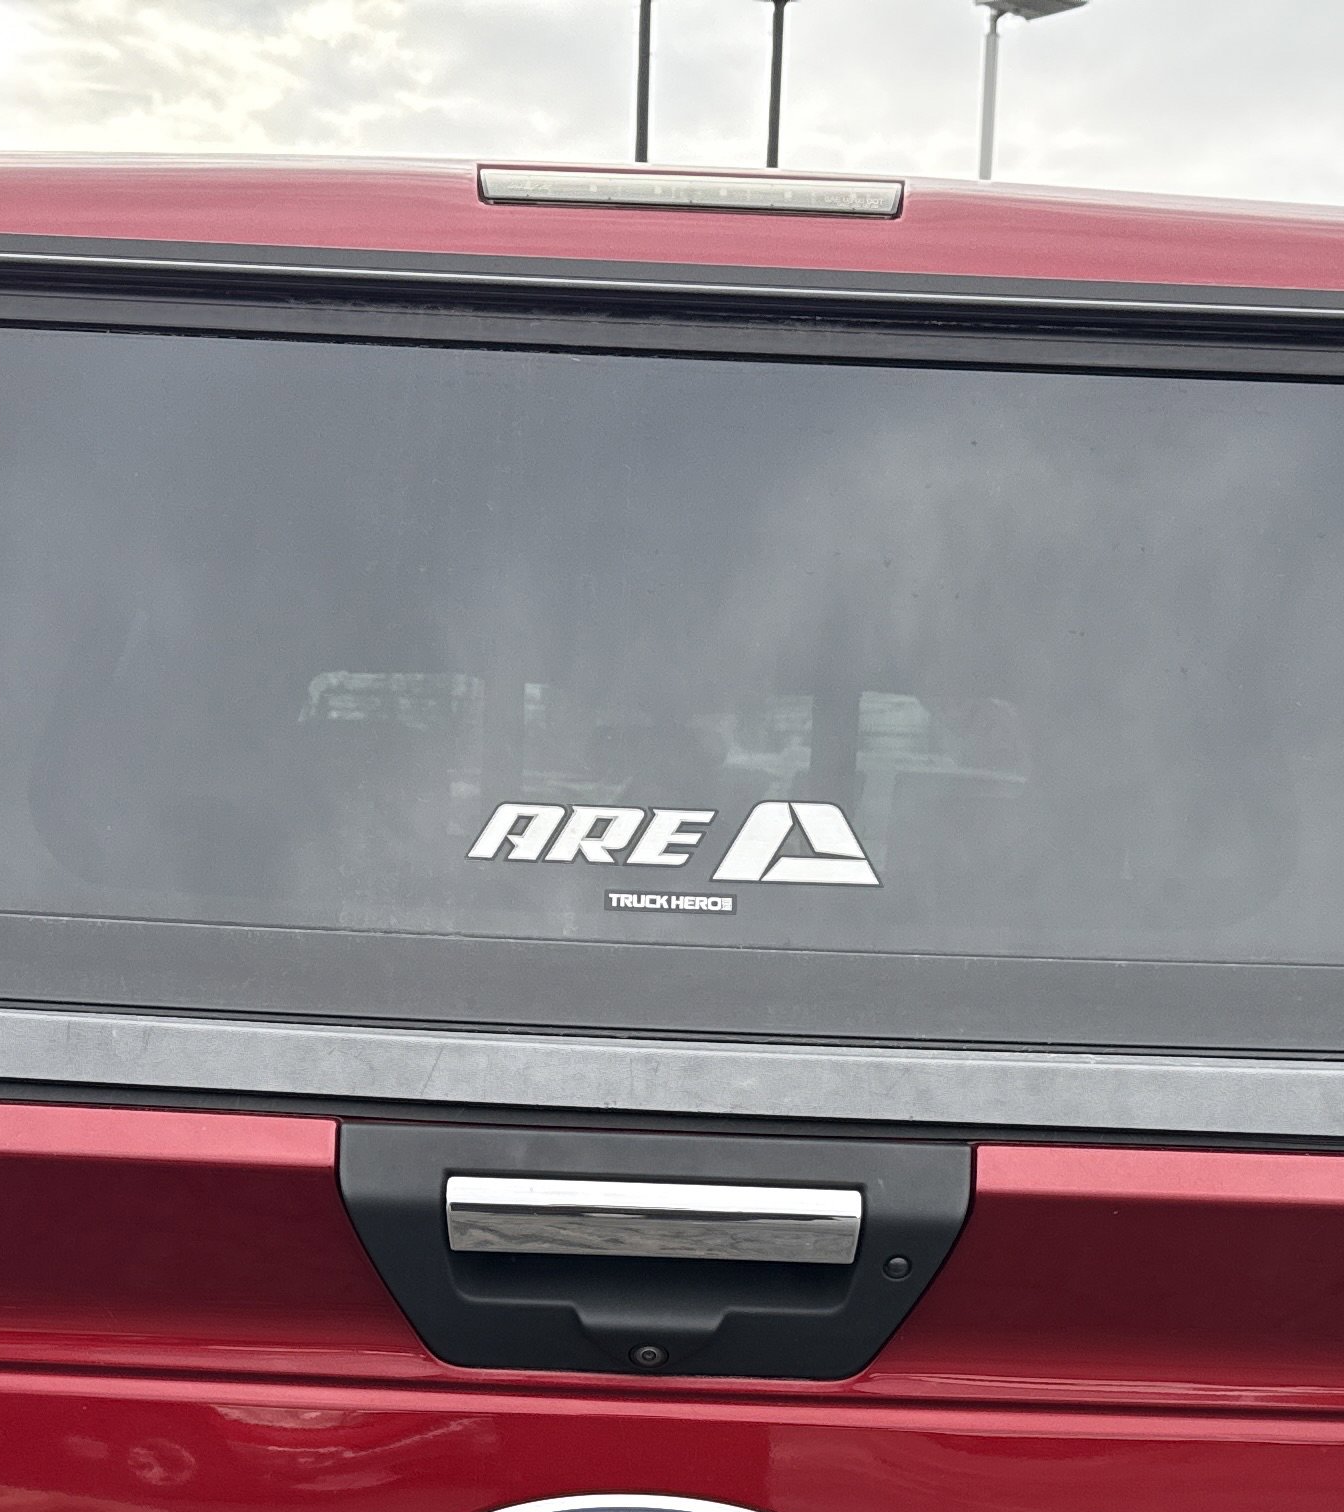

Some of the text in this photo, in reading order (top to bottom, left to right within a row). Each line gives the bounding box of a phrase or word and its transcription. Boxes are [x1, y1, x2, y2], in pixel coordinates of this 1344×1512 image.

[465, 802, 718, 867] ARE
[608, 893, 669, 909] TRUCK
[670, 896, 722, 911] HERO
